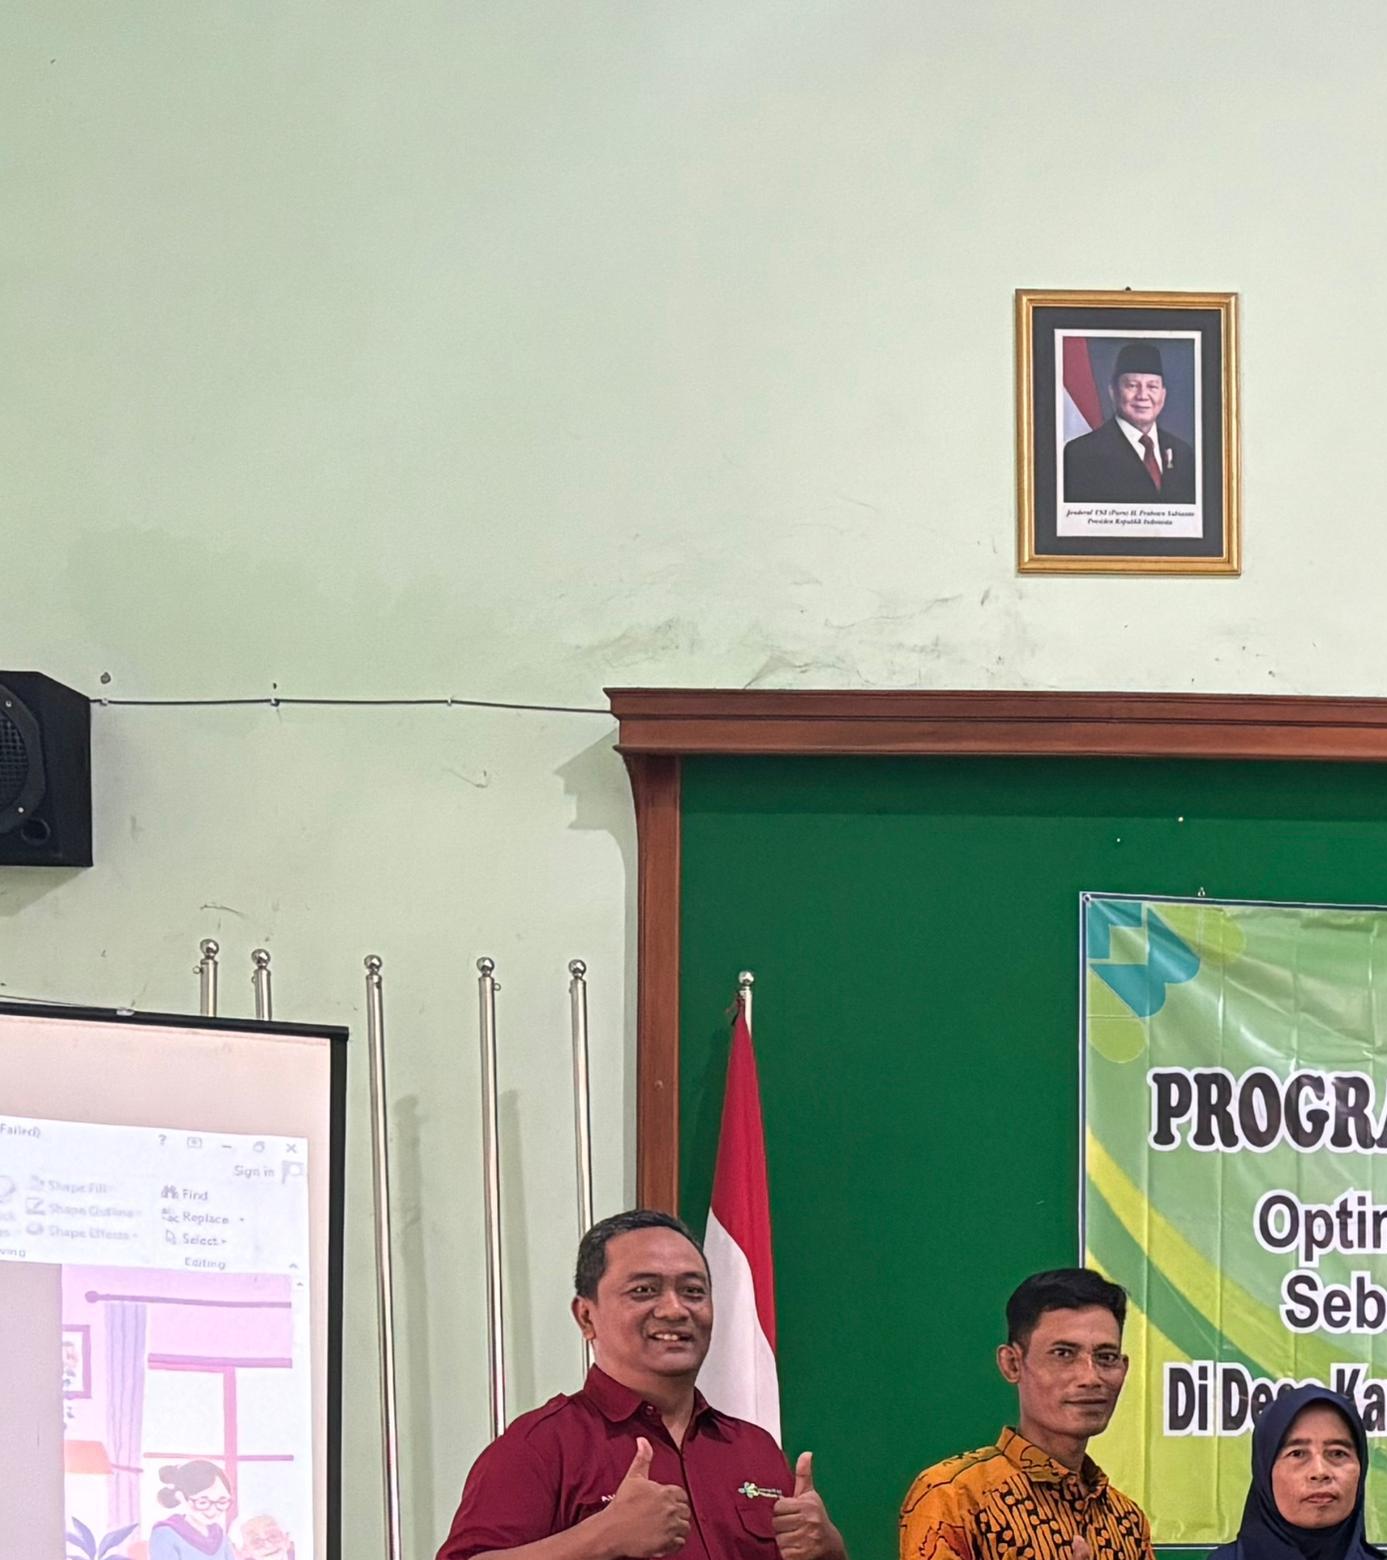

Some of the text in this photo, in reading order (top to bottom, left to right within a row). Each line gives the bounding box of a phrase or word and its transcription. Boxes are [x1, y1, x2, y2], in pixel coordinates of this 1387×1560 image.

[233, 1164, 259, 1178] Sign
[182, 1188, 209, 1202] Find
[182, 1211, 230, 1226] Replace
[1169, 1366, 1208, 1431] Di
